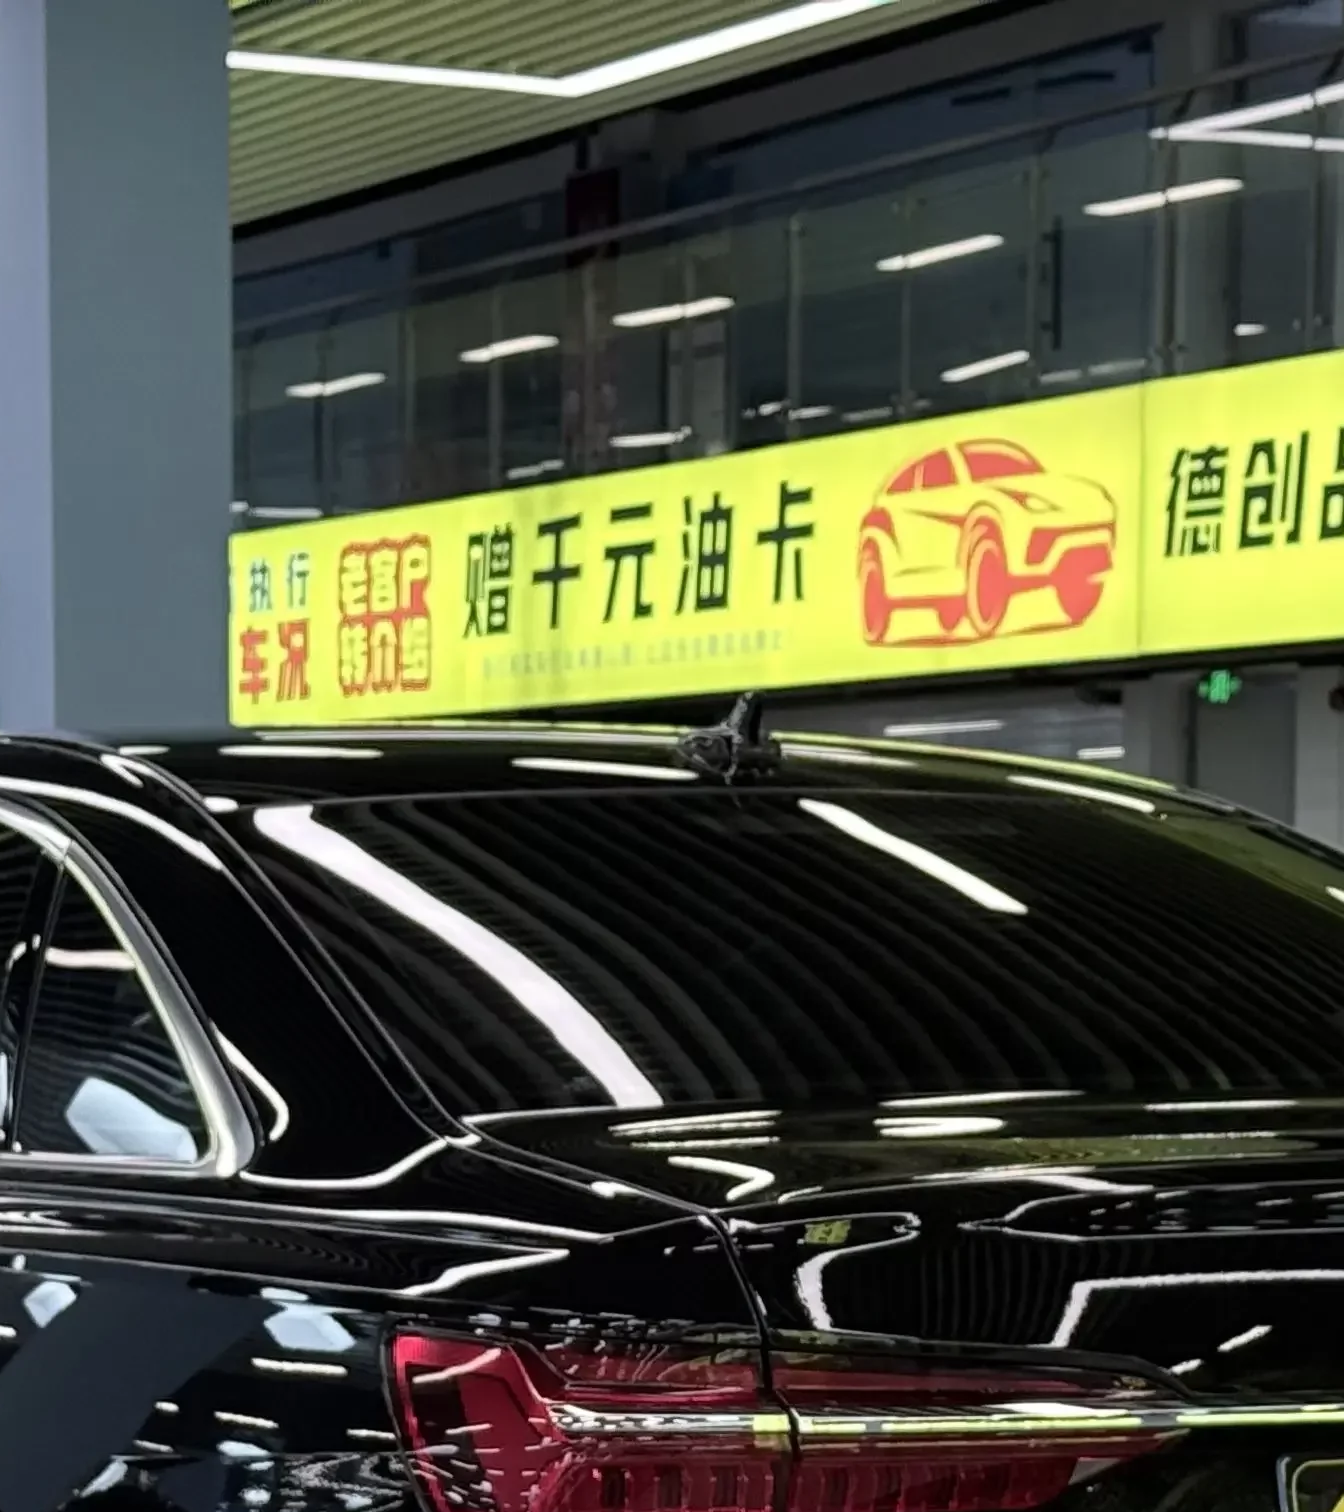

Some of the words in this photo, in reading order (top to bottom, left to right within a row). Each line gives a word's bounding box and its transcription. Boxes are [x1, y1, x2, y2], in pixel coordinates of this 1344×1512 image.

[462, 482, 814, 638] 赠千元油卡
[239, 618, 311, 704] 车况
